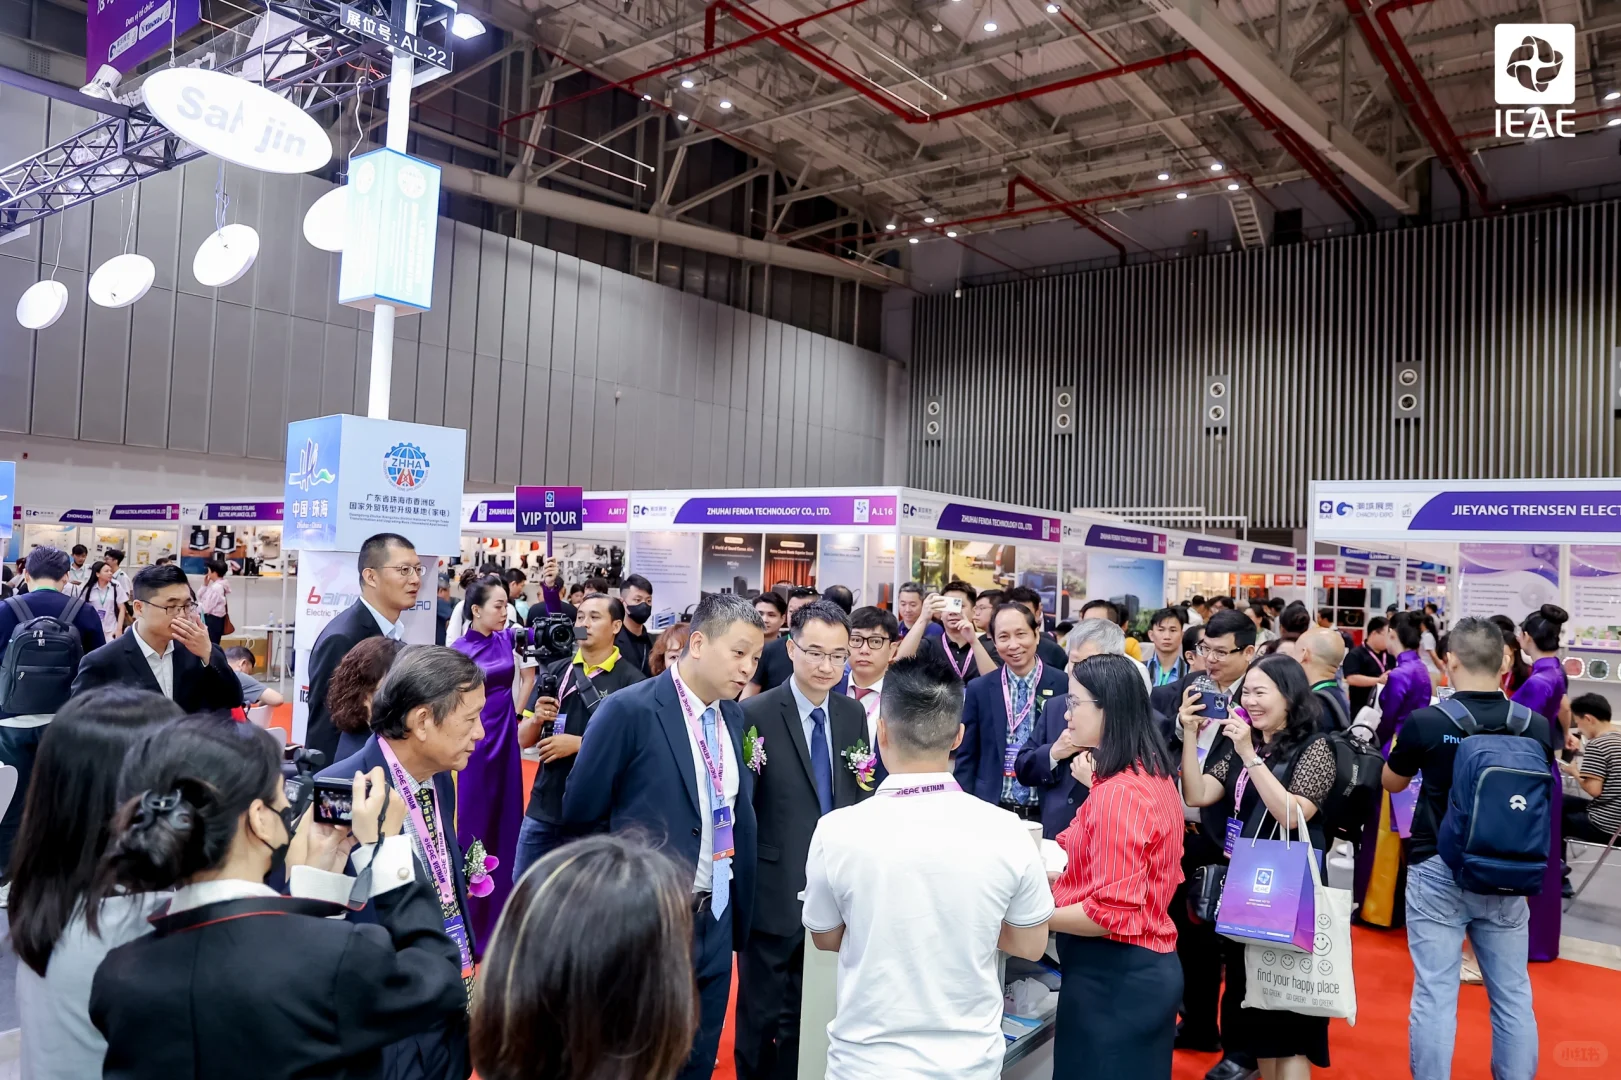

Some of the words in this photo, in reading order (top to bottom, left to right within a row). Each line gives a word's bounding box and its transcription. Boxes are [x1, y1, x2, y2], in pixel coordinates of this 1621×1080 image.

[391, 458, 422, 470] ZHHA
[755, 507, 800, 515] TECHNOLOGY
[801, 507, 815, 516] CO.,
[816, 507, 831, 515] LTD.
[872, 508, 893, 516] A.L16
[1451, 505, 1508, 516] JIEYANG
[1511, 505, 1576, 516] TRENSEN
[522, 512, 541, 526] VIP
[544, 511, 576, 525] TOUR
[1444, 734, 1464, 744] Phu
[922, 784, 944, 793] VIETNAM
[403, 785, 417, 811] VIETNAM
[432, 856, 446, 884] VIETNAM
[1258, 968, 1271, 982] find
[1274, 974, 1290, 987] your
[1292, 975, 1314, 994] happy
[1317, 980, 1340, 995] place
